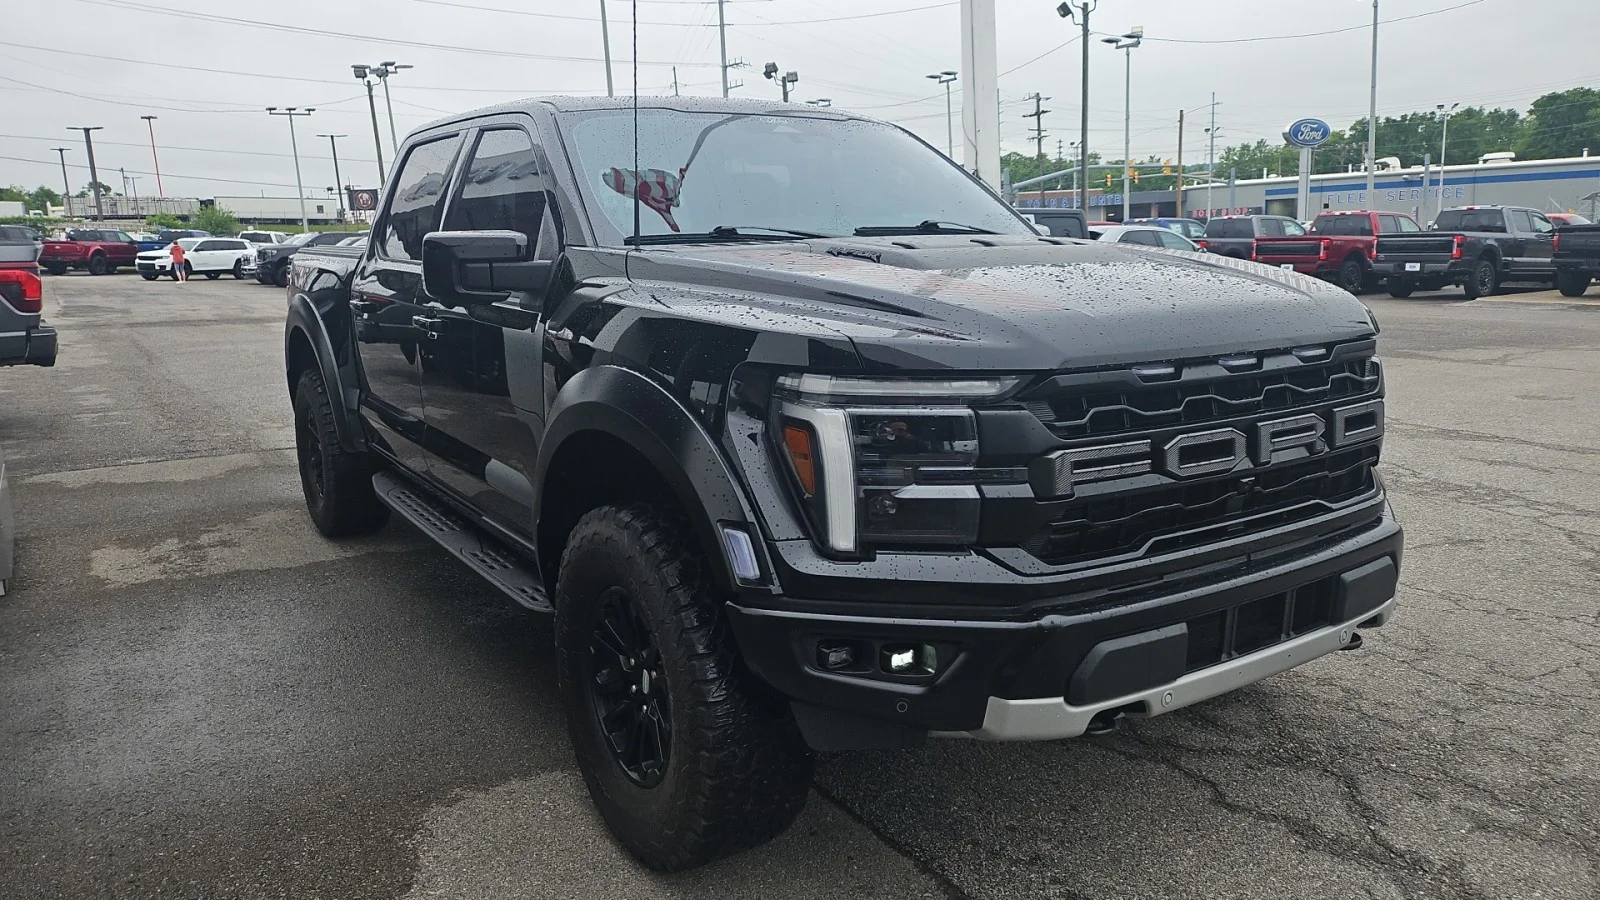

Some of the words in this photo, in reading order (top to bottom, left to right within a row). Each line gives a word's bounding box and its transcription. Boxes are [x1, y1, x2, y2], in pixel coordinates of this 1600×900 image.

[1297, 122, 1324, 140] Ford
[1026, 198, 1058, 208] TON
[1075, 194, 1126, 207] CUNTR
[1387, 187, 1465, 202] SERICE
[1050, 398, 1385, 498] FORD
